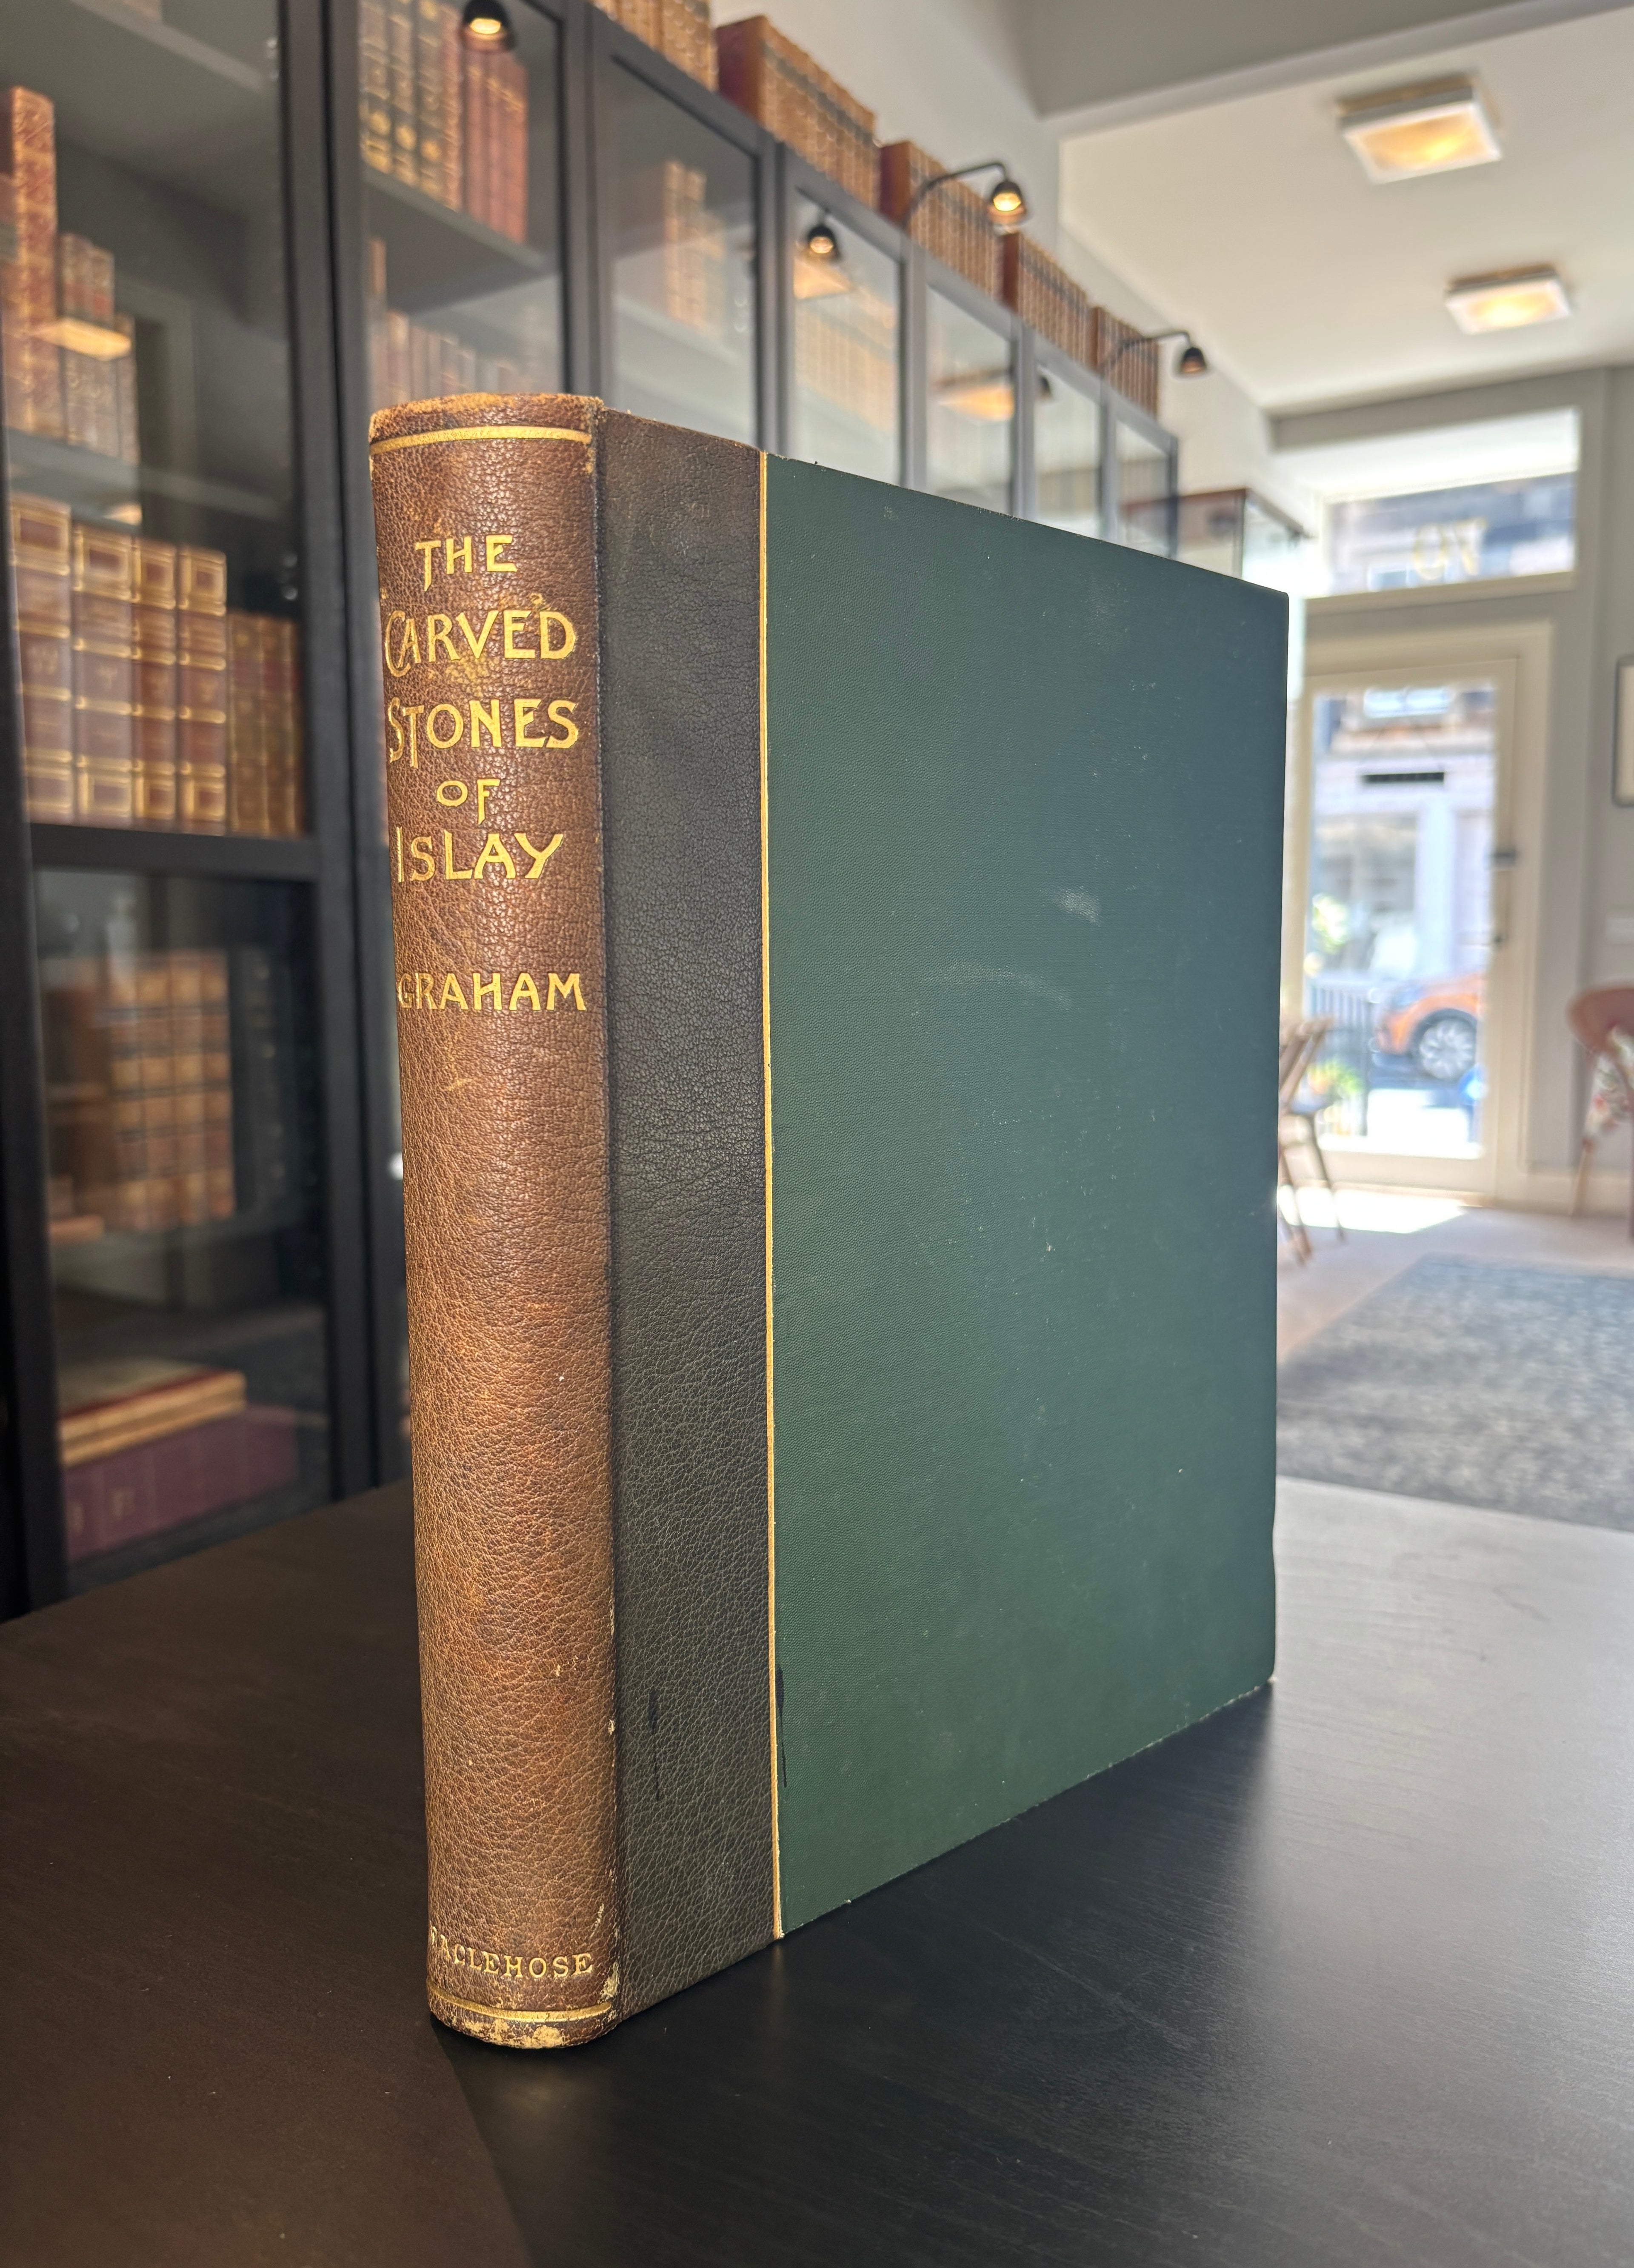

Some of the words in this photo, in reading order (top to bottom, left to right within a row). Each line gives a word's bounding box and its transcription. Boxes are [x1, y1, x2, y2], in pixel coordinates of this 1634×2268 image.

[415, 535, 517, 592] THE
[385, 610, 576, 678] CARVED
[388, 697, 579, 769] STONES
[437, 779, 500, 825] OF
[396, 827, 564, 883] ISLAY
[397, 973, 586, 1011] GRAHAM
